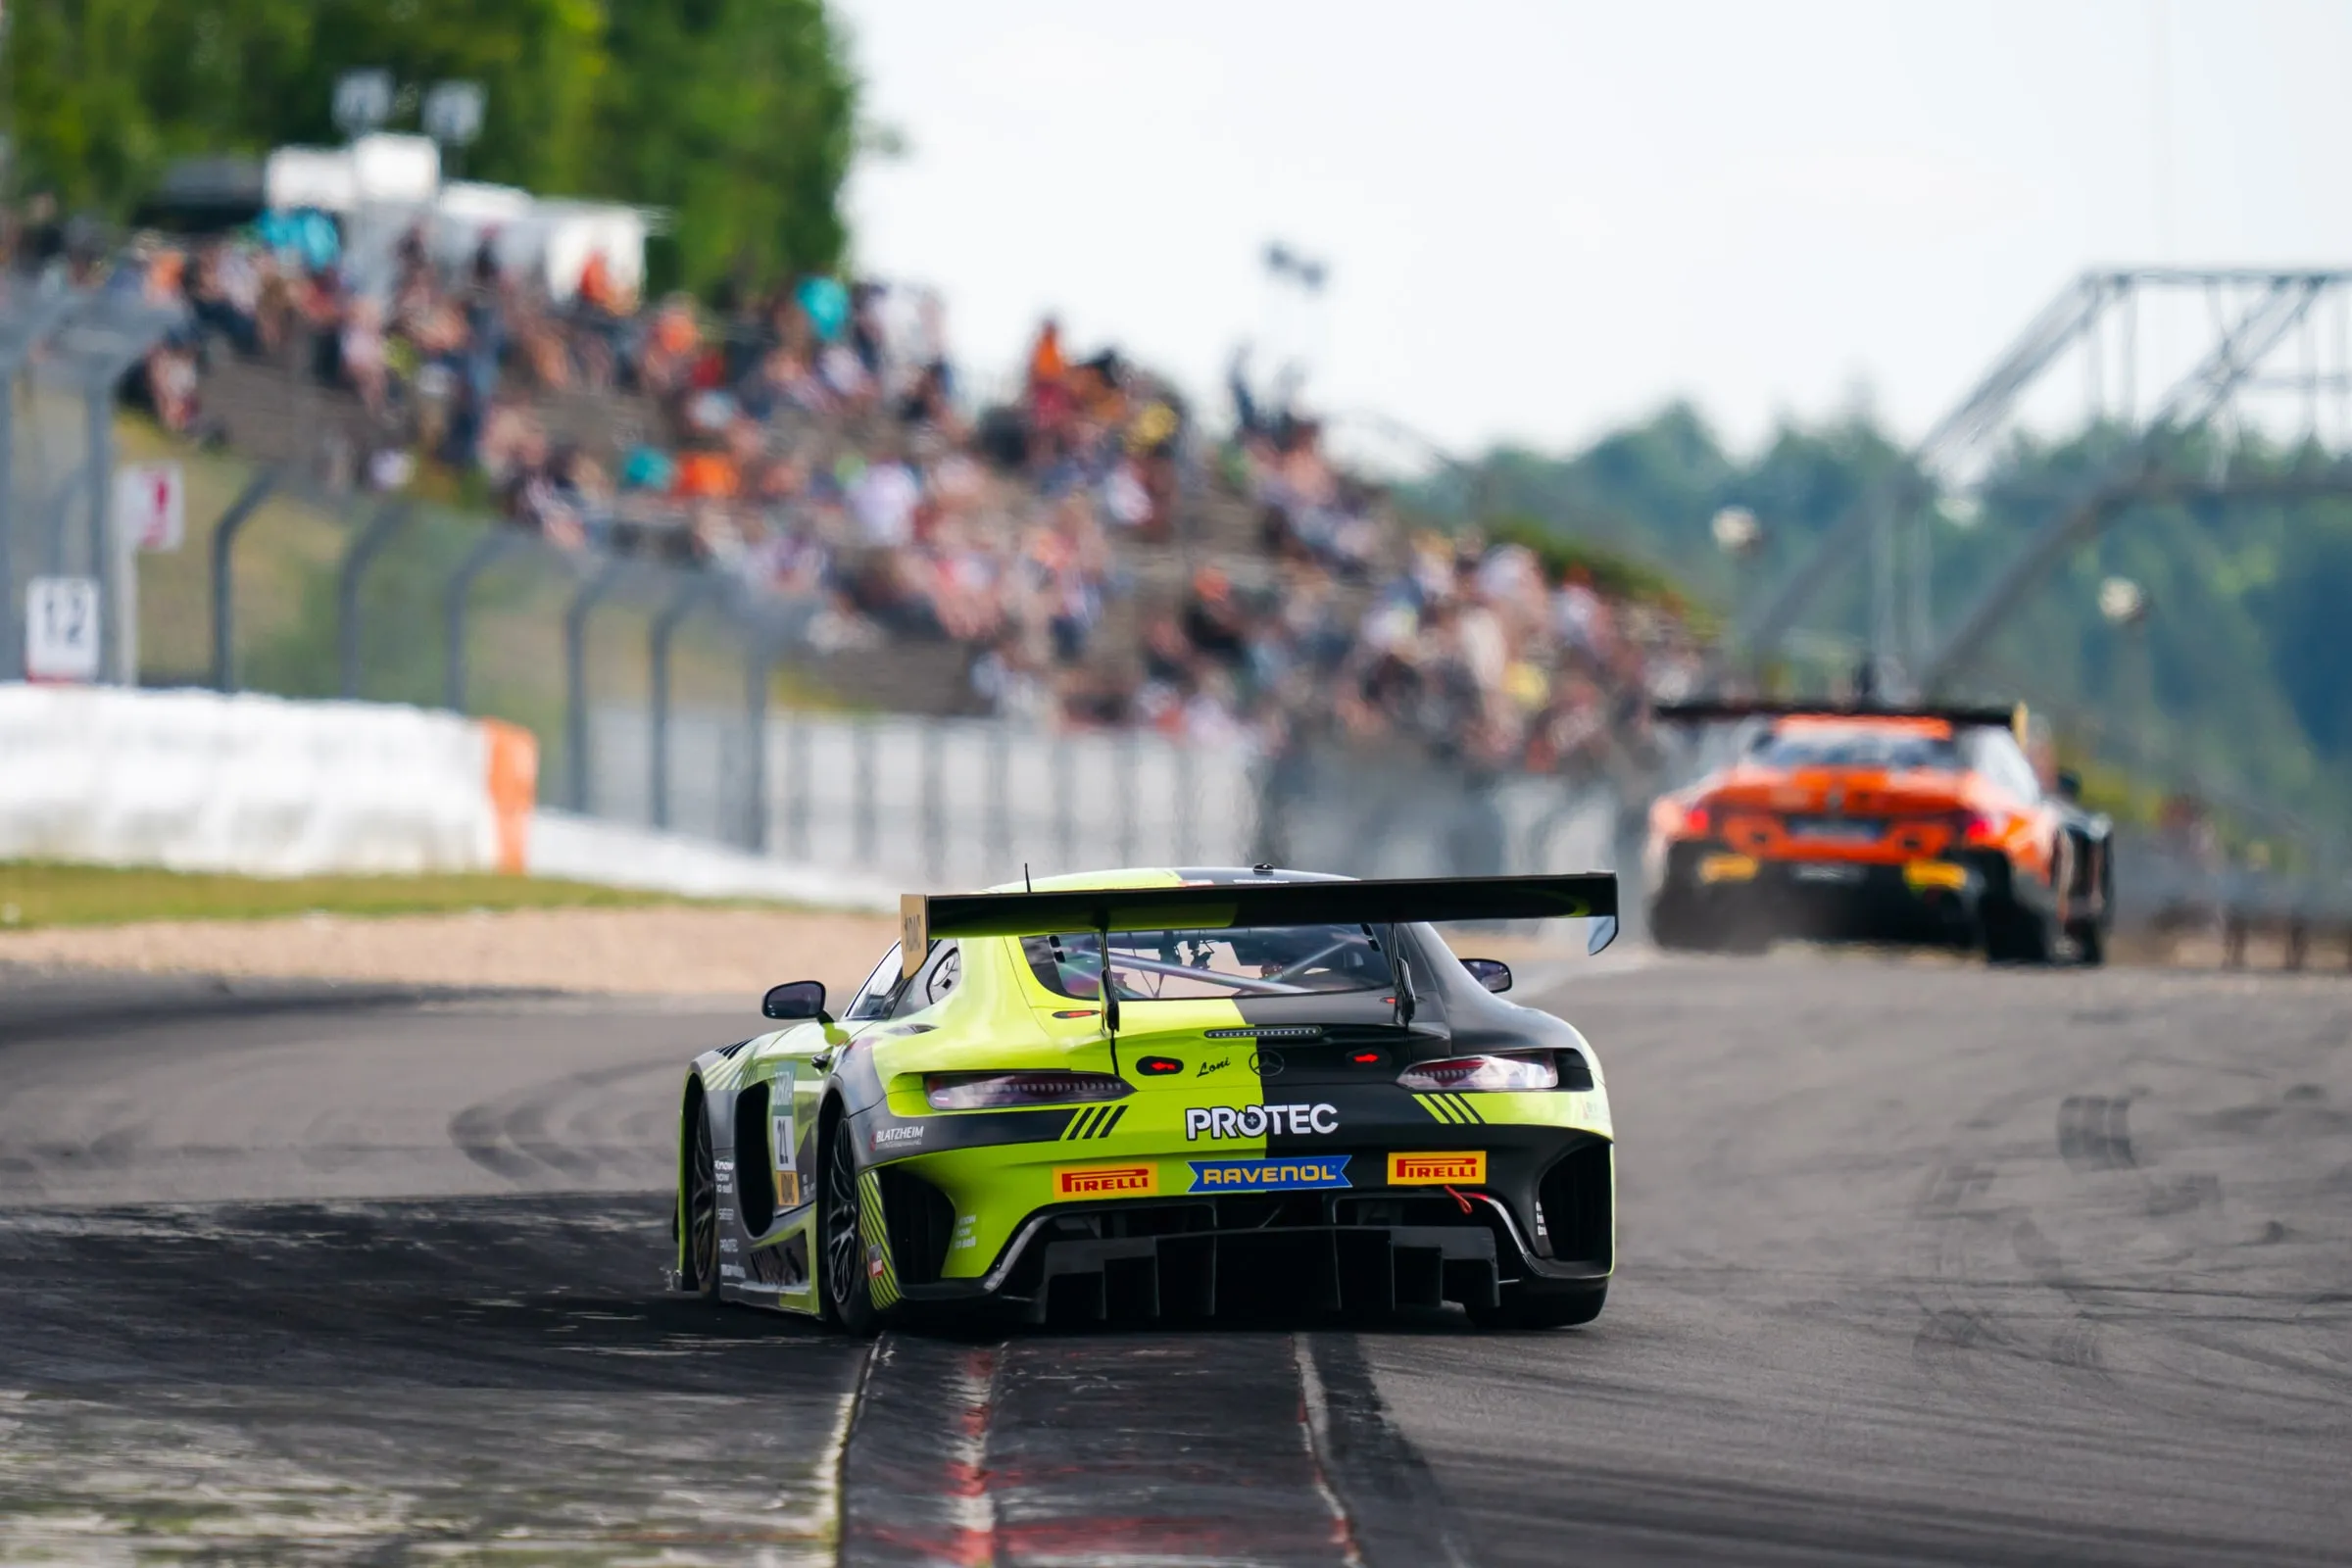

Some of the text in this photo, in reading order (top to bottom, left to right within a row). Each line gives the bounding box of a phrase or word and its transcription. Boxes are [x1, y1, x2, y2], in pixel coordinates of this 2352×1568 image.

[1197, 1057, 1231, 1078] Loni
[1186, 1102, 1340, 1141] PROTEC
[777, 1119, 789, 1164] 21
[876, 1125, 924, 1144] BLATZHEIM
[1202, 1165, 1337, 1185] RAVENOL
[1396, 1157, 1477, 1178] PIRELLI
[1061, 1168, 1149, 1193] PIRELLI
